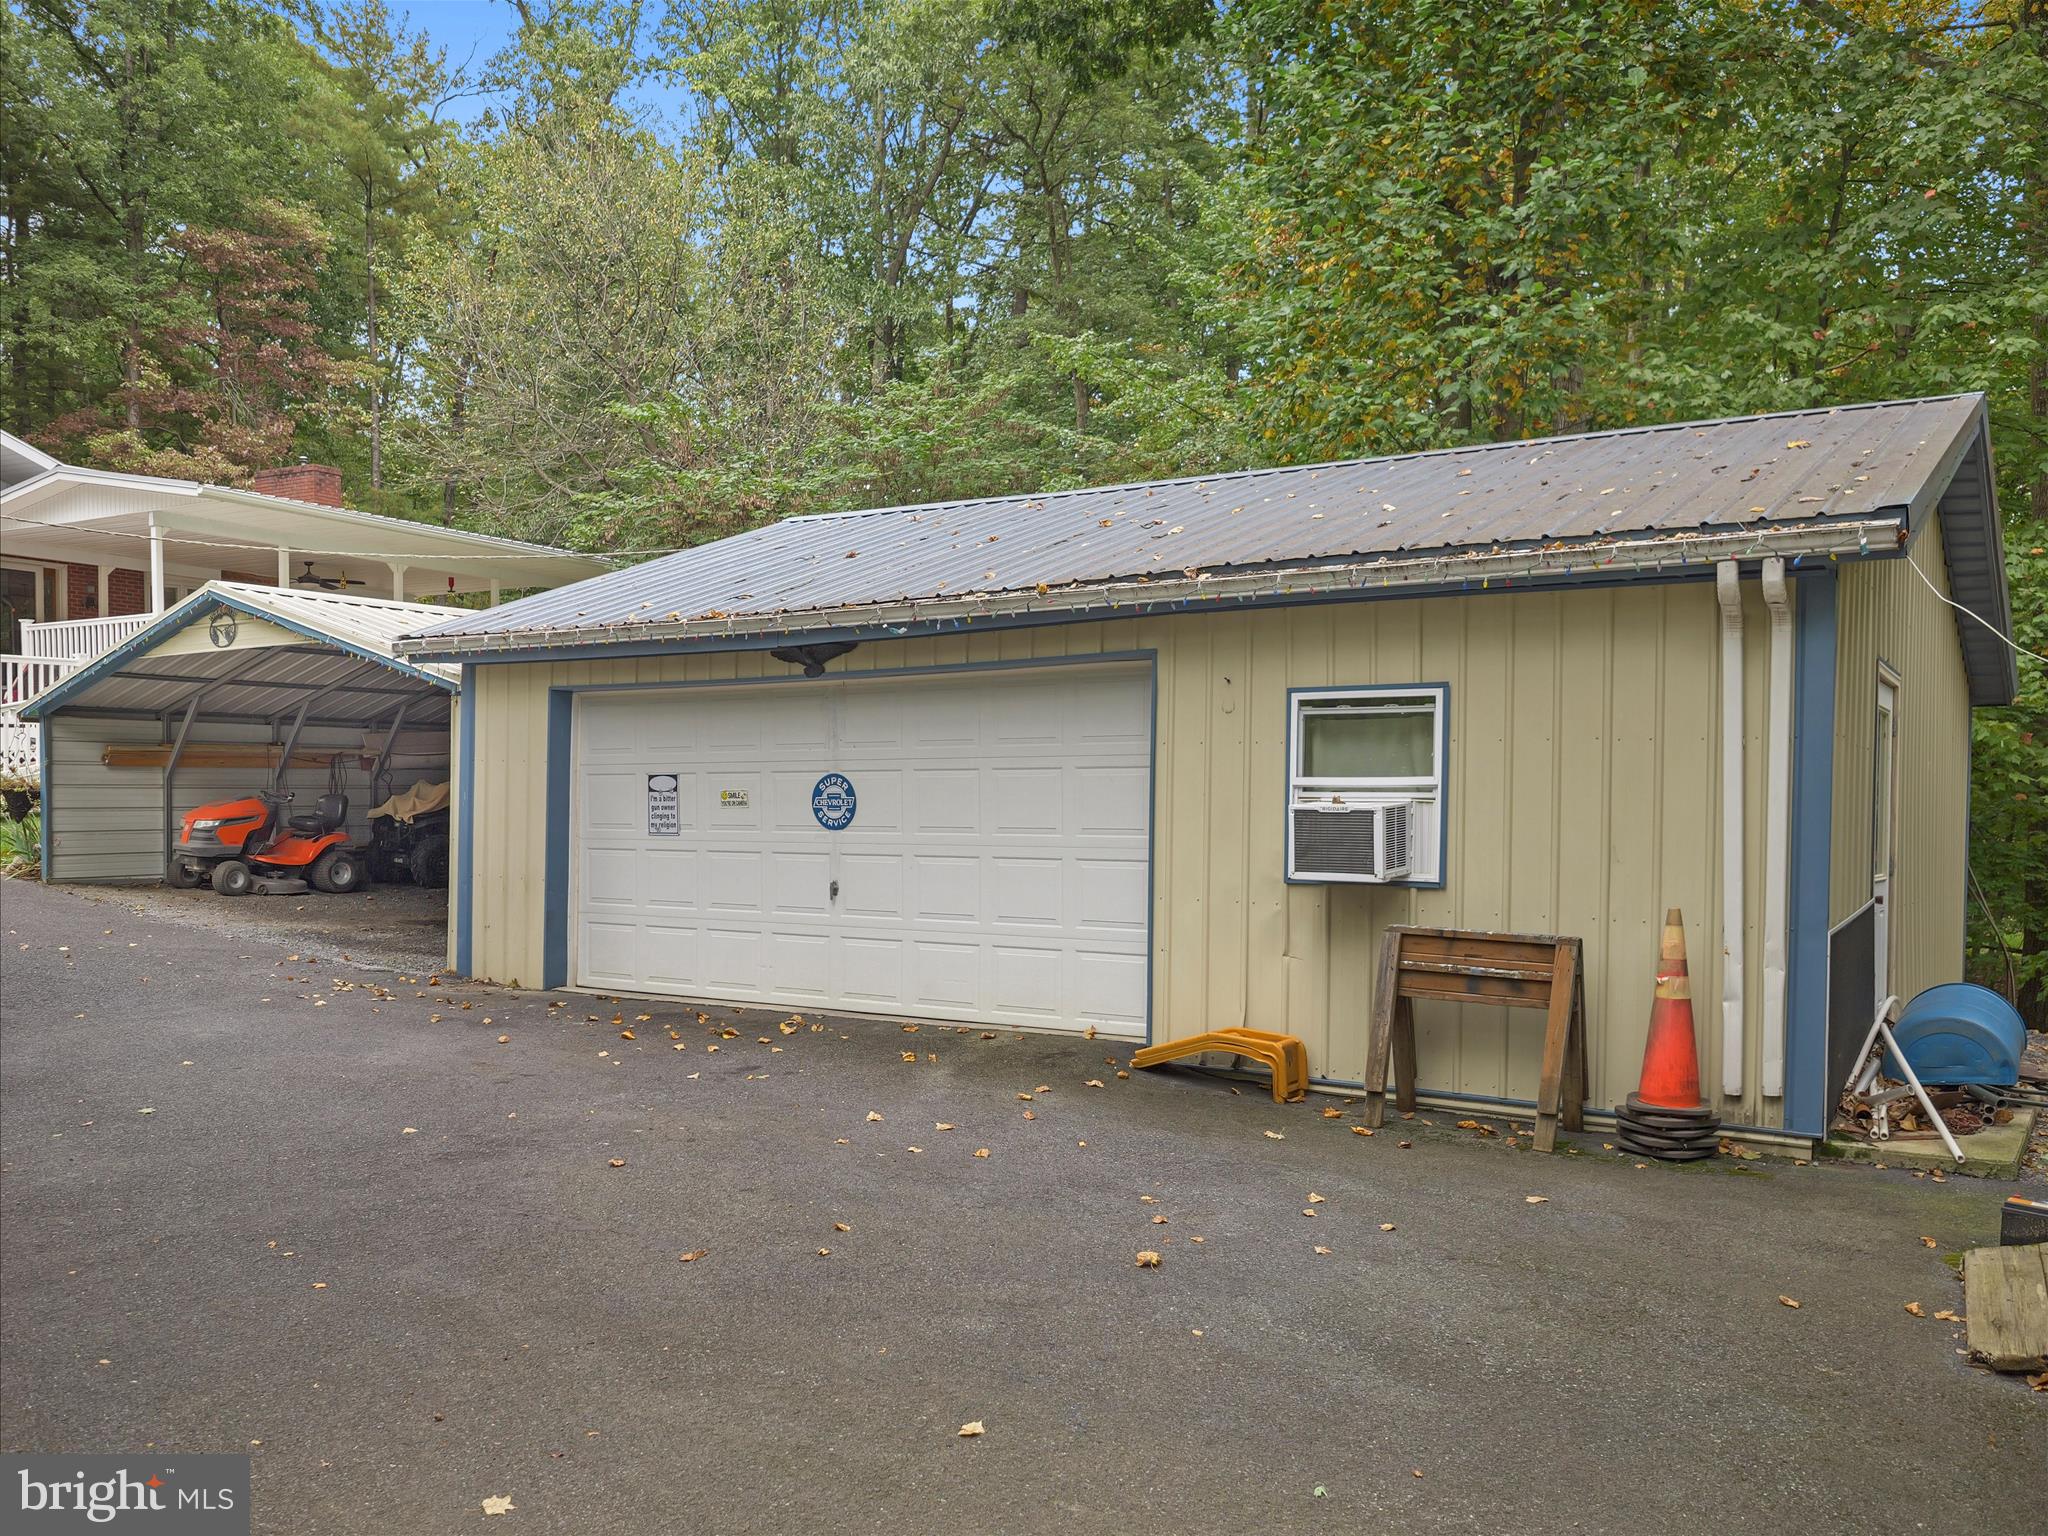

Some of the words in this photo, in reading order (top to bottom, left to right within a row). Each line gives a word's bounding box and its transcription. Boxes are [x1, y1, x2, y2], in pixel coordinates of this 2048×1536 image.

[819, 777, 848, 791] SUPER
[651, 813, 670, 821] clinging
[817, 811, 851, 827] SERVICE
[659, 821, 677, 829] religion
